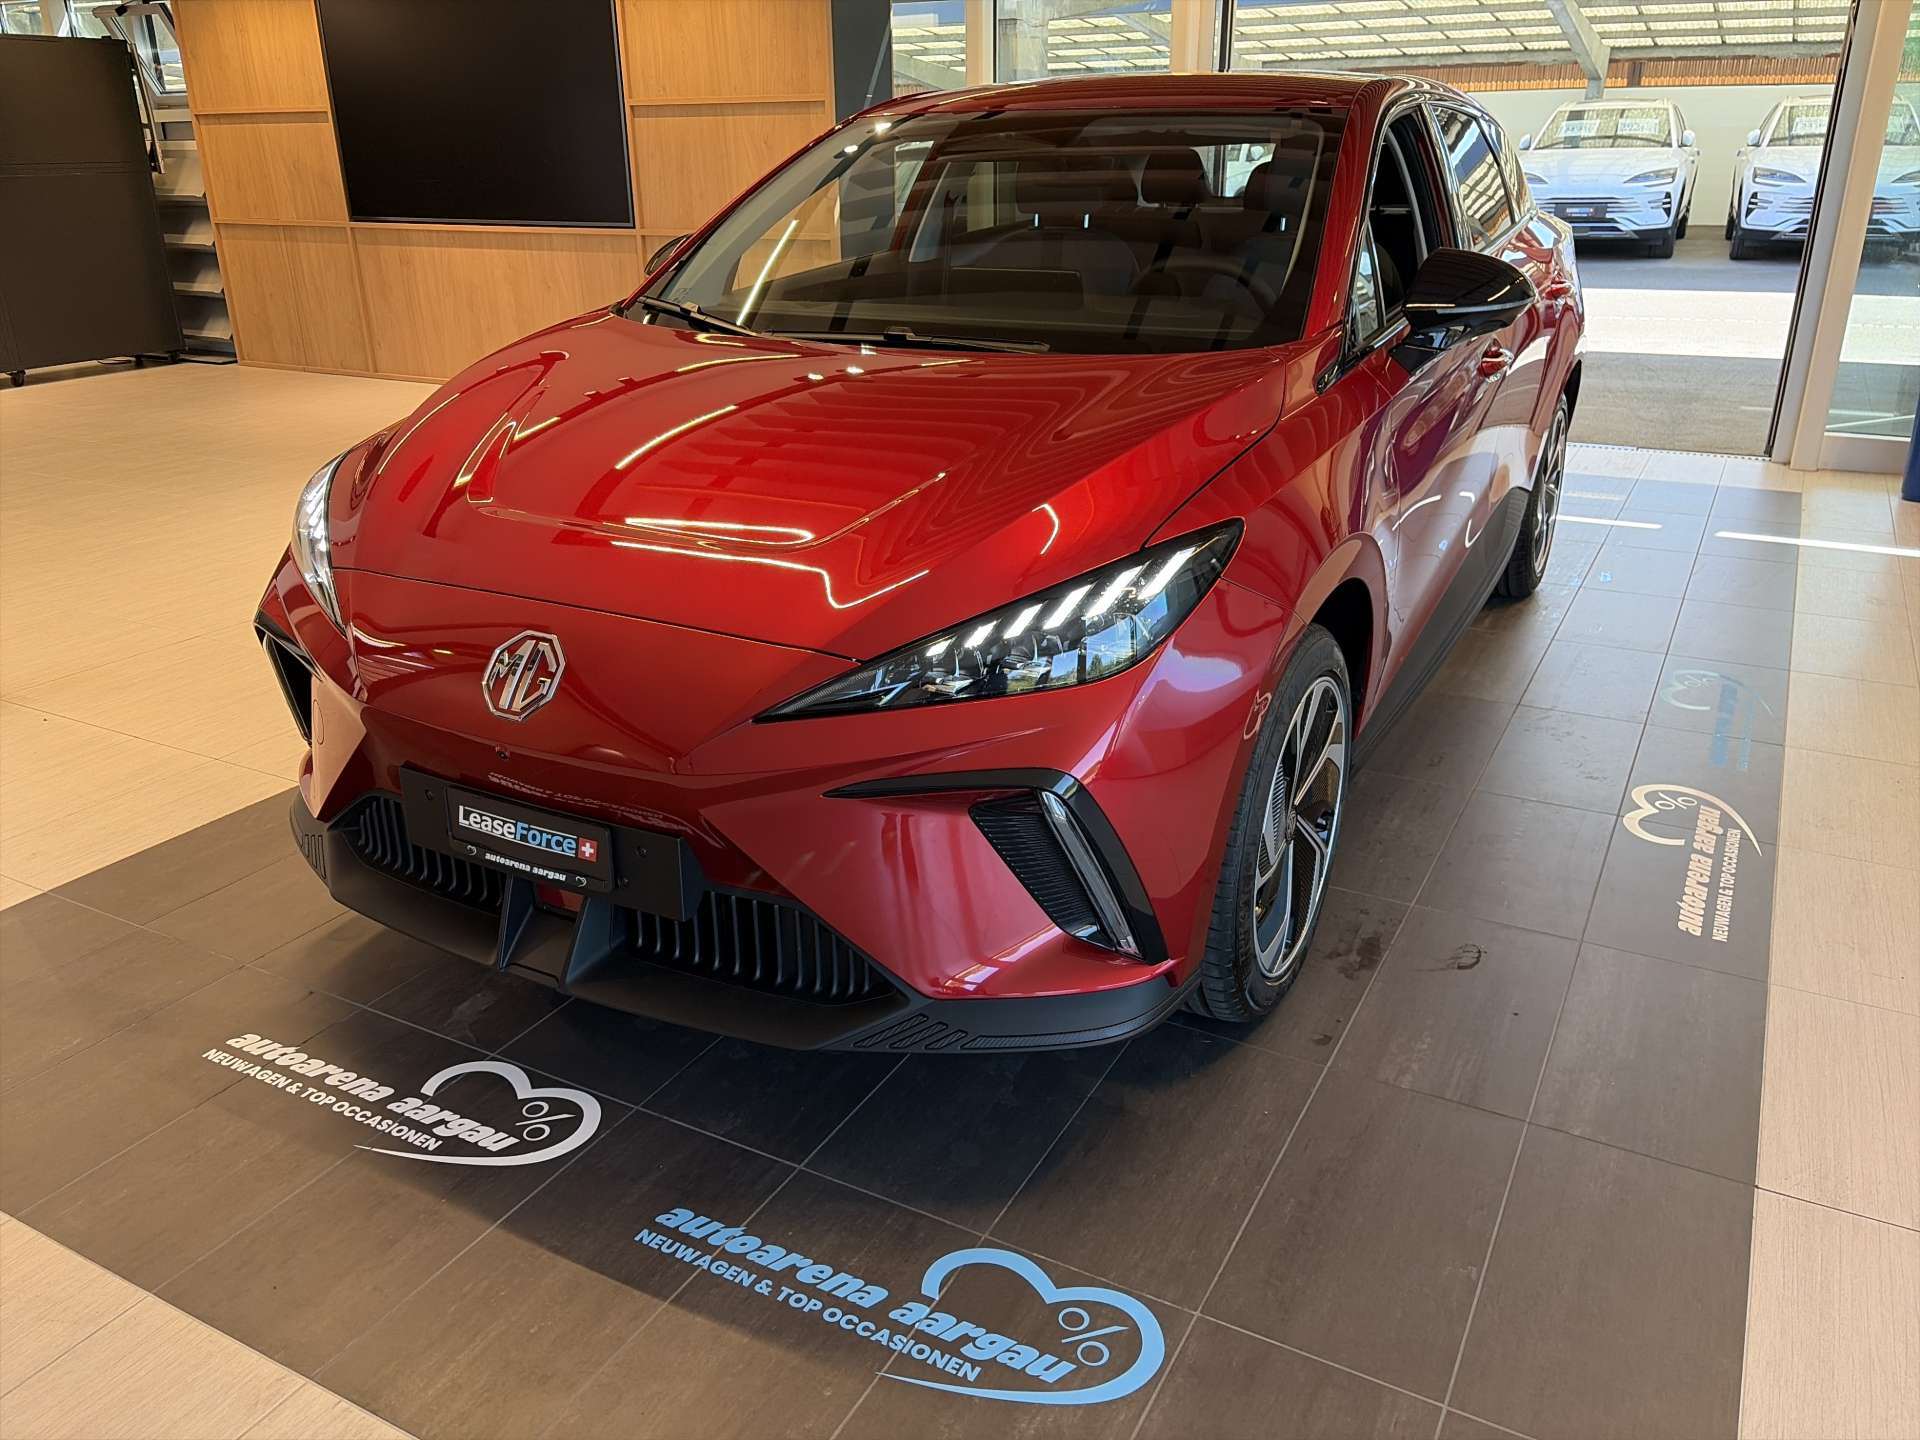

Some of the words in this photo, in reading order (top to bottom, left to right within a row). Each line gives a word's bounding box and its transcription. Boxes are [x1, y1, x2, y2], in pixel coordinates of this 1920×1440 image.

[488, 639, 558, 713] MG
[458, 804, 577, 855] LeaseForce
[1692, 804, 1724, 854] aargau
[1721, 827, 1742, 874] OCCASIONEN
[484, 852, 531, 872] autoarena
[532, 866, 567, 882] aargau
[1676, 853, 1713, 937] autoarena
[1719, 872, 1736, 889] TOP
[1711, 894, 1733, 942] NEUWAGEN
[201, 1048, 292, 1089] NEUWAGEN
[285, 1082, 304, 1095] &
[300, 1087, 337, 1106] TOP
[332, 1101, 443, 1151] OCCASIONEN
[225, 1033, 395, 1102] autoarena
[386, 1097, 521, 1152] aargau
[634, 1228, 758, 1288] NEUWAGEN
[754, 1279, 774, 1296] &
[776, 1286, 824, 1313] TOP
[822, 1307, 983, 1383] OCCASIONEN
[655, 1207, 889, 1309] autoarena
[888, 1301, 1078, 1384] aargau
